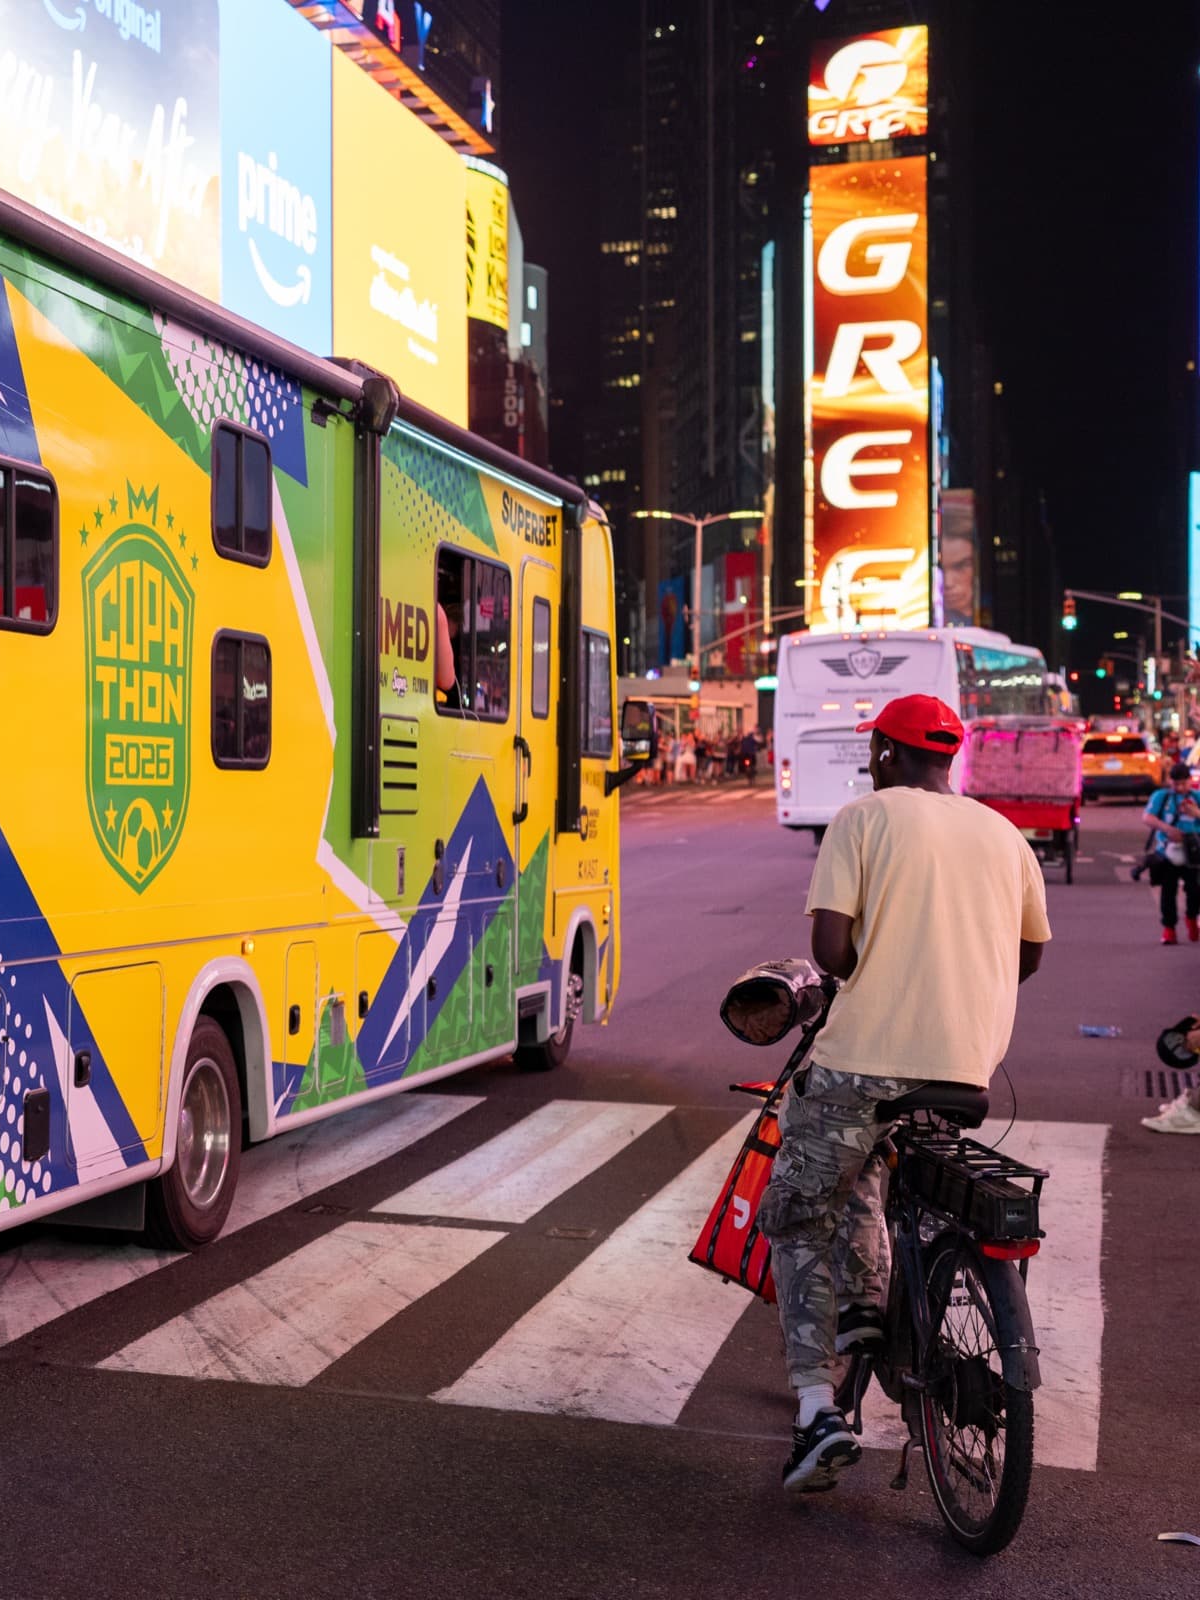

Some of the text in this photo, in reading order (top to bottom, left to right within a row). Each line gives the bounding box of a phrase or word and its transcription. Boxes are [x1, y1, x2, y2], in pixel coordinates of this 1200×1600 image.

[237, 151, 318, 256] prime
[817, 212, 922, 630] GREE
[501, 490, 558, 548] SUPERBET
[94, 559, 185, 669] COPA
[380, 597, 431, 663] IMED
[95, 664, 184, 725] THON
[108, 740, 170, 780] 2026
